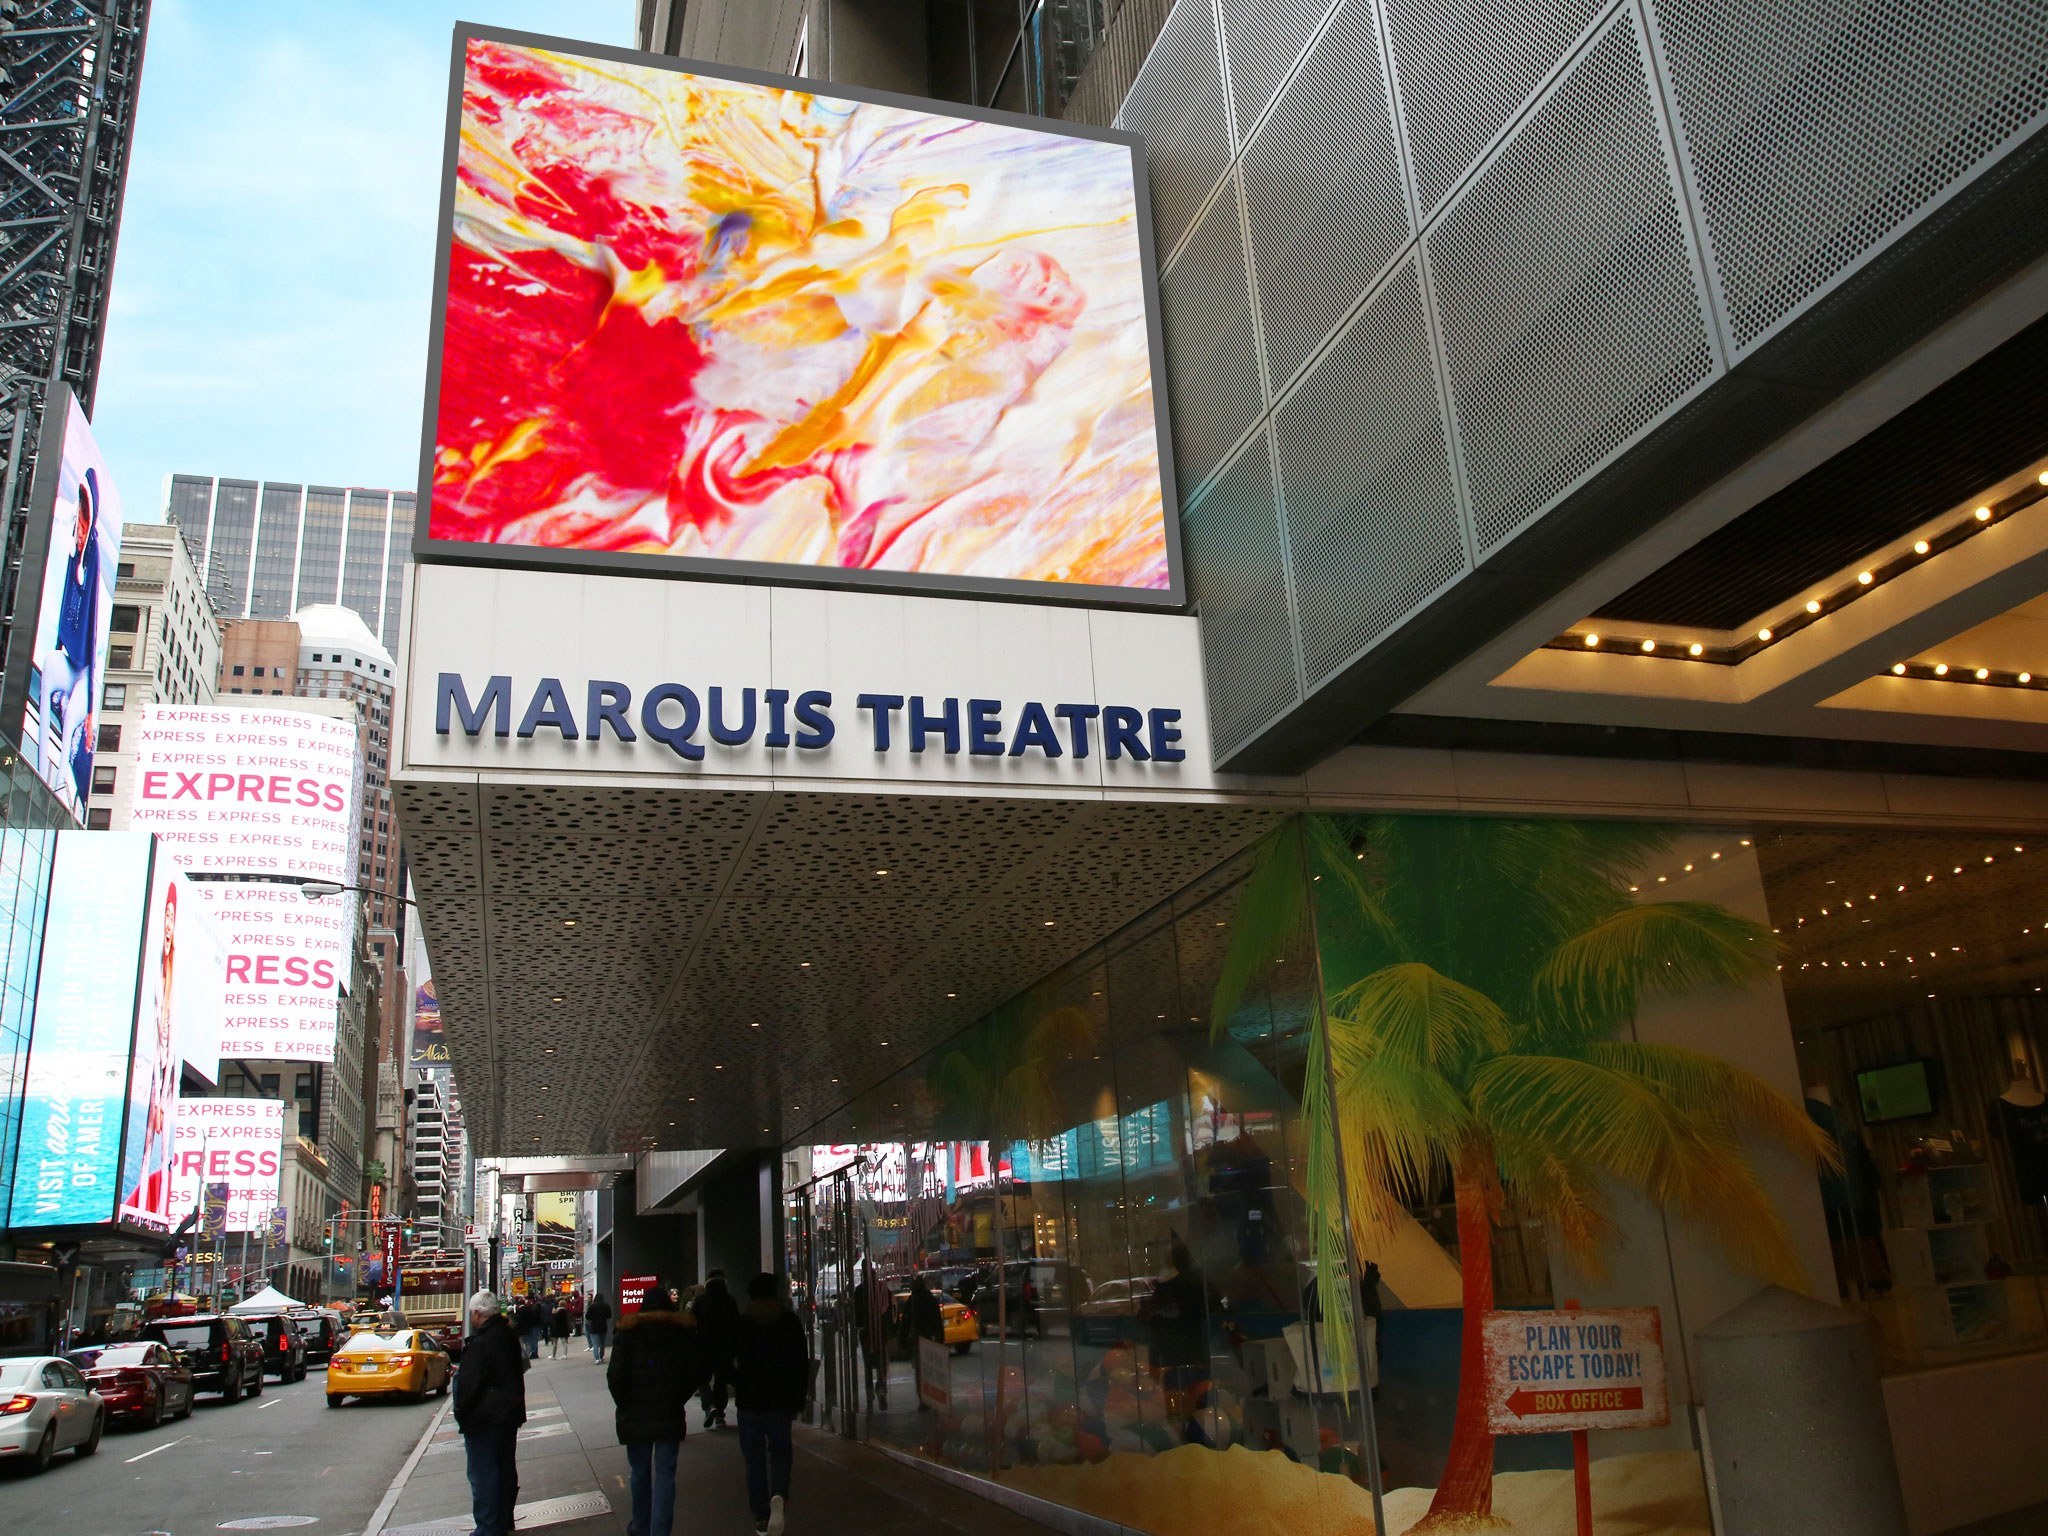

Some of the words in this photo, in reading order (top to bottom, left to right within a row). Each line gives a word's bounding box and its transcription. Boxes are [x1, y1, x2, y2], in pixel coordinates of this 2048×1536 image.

[156, 710, 231, 723] EXPRESS
[240, 714, 312, 730] EXPRESS
[435, 672, 836, 761] MARQUIS
[856, 693, 1187, 763] THEATRE
[215, 733, 288, 747] EXPRESS
[152, 752, 226, 765] EXPRESS
[236, 755, 308, 770] EXPRESS
[142, 771, 345, 812] EXPRESS
[207, 811, 281, 825] EXPRESS
[229, 833, 302, 848] EXPRESS
[203, 855, 278, 869] EXPRESS
[224, 889, 298, 902] EXPRESS
[177, 1104, 256, 1116] EXPRESS
[209, 1127, 282, 1138] EXPRESS
[71, 1160, 98, 1187] OF
[34, 1158, 67, 1215] VISIT
[622, 1289, 644, 1297] Hotel
[1526, 1326, 1570, 1350] PLAN
[1576, 1324, 1622, 1349] YOUR
[1508, 1354, 1576, 1381] ESCAPE
[1580, 1352, 1642, 1378] TODAY!
[1535, 1393, 1567, 1411] BOX
[1571, 1391, 1624, 1410] OFFICE
